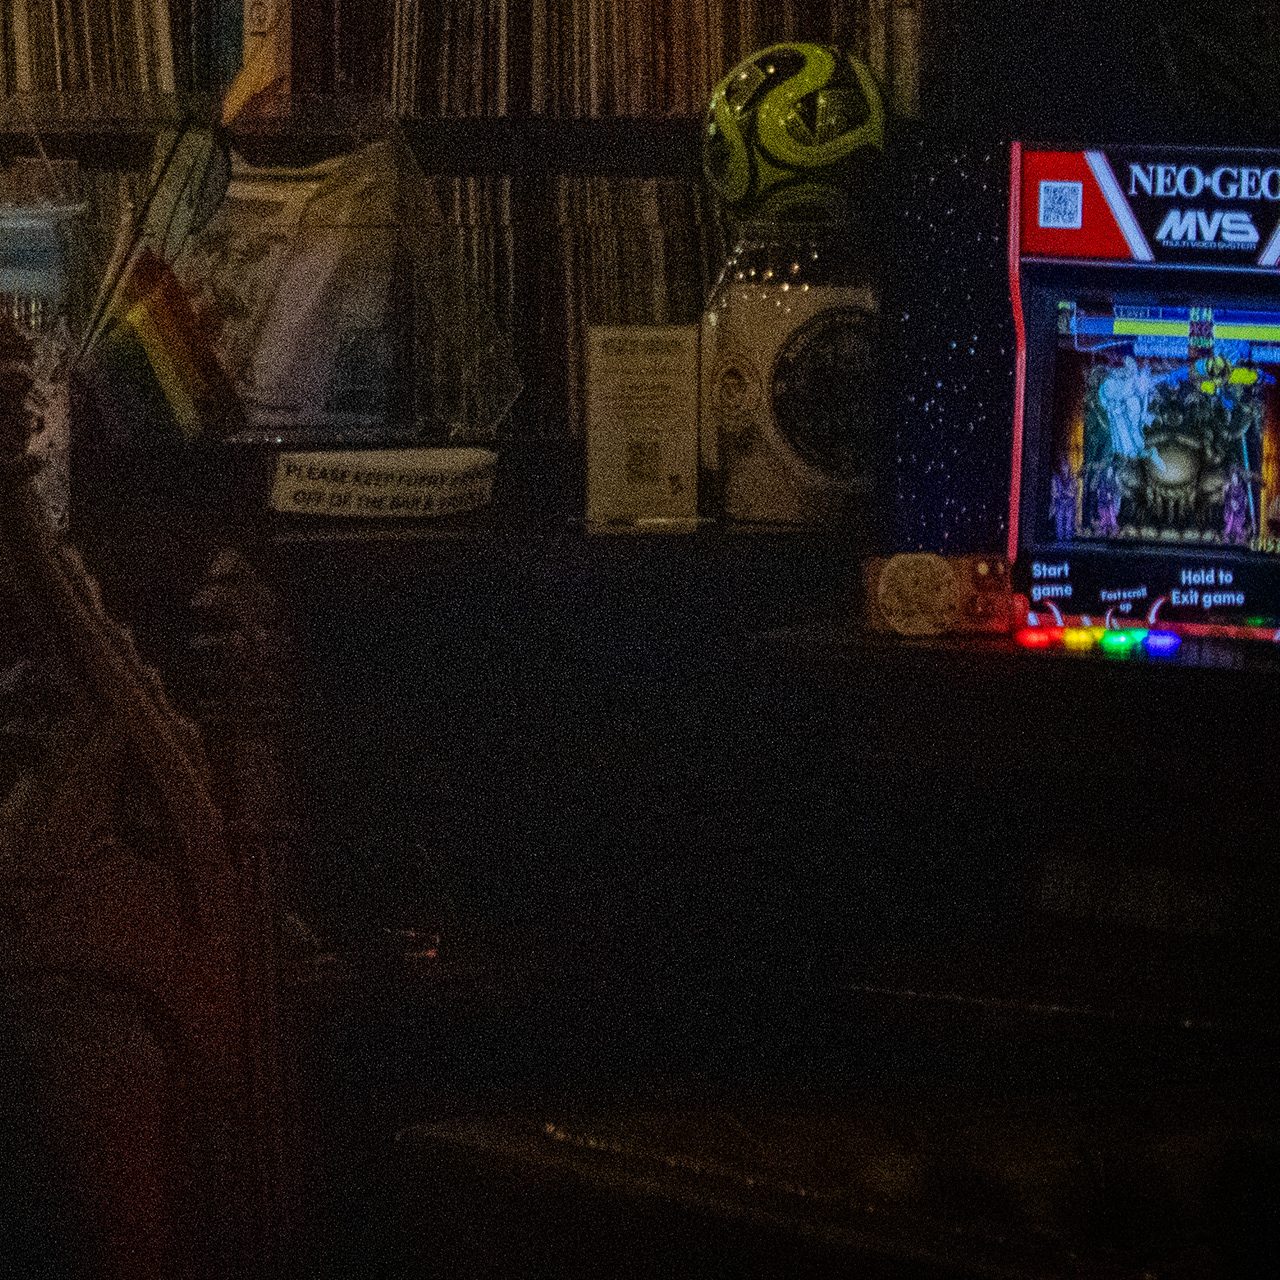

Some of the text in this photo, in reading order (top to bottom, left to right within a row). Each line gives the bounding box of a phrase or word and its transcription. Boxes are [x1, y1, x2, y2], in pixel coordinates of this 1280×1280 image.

[1155, 209, 1260, 243] MVS
[1032, 562, 1070, 578] Start
[1182, 569, 1234, 585] Hold to
[1032, 584, 1073, 602] game
[1171, 589, 1245, 609] Exit game
[1119, 601, 1133, 613] up
